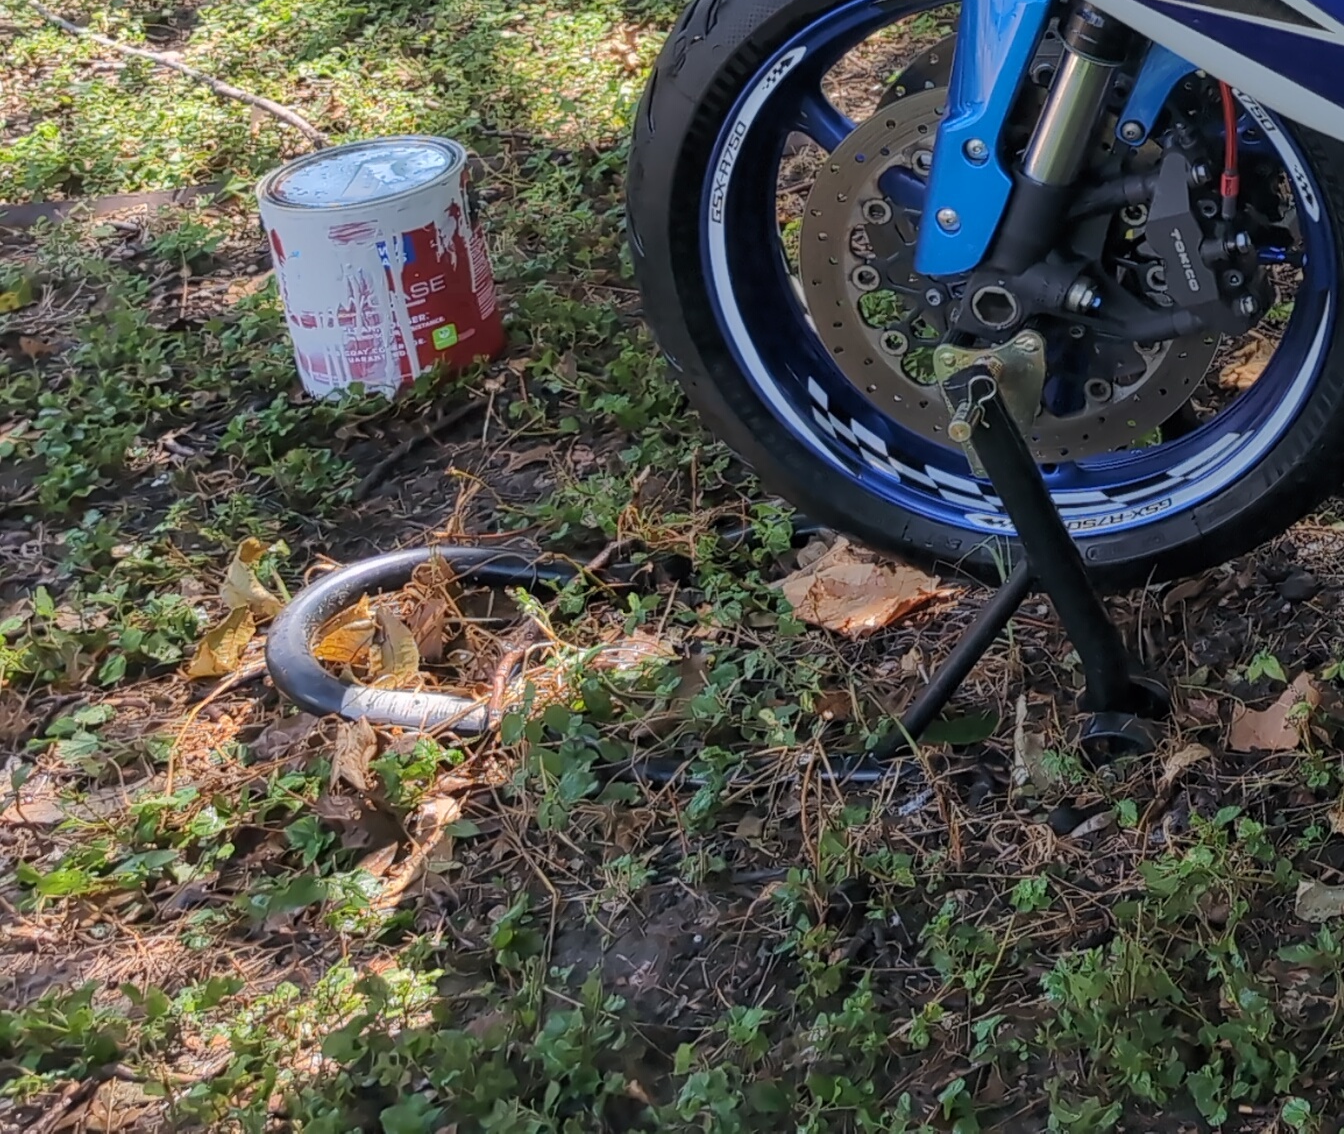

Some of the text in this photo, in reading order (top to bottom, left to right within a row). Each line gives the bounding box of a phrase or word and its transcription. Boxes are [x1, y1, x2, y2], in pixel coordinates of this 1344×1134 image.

[711, 122, 747, 224] GSX-R750
[1170, 227, 1200, 292] TOKICO
[1065, 498, 1172, 531] GSX-R750
